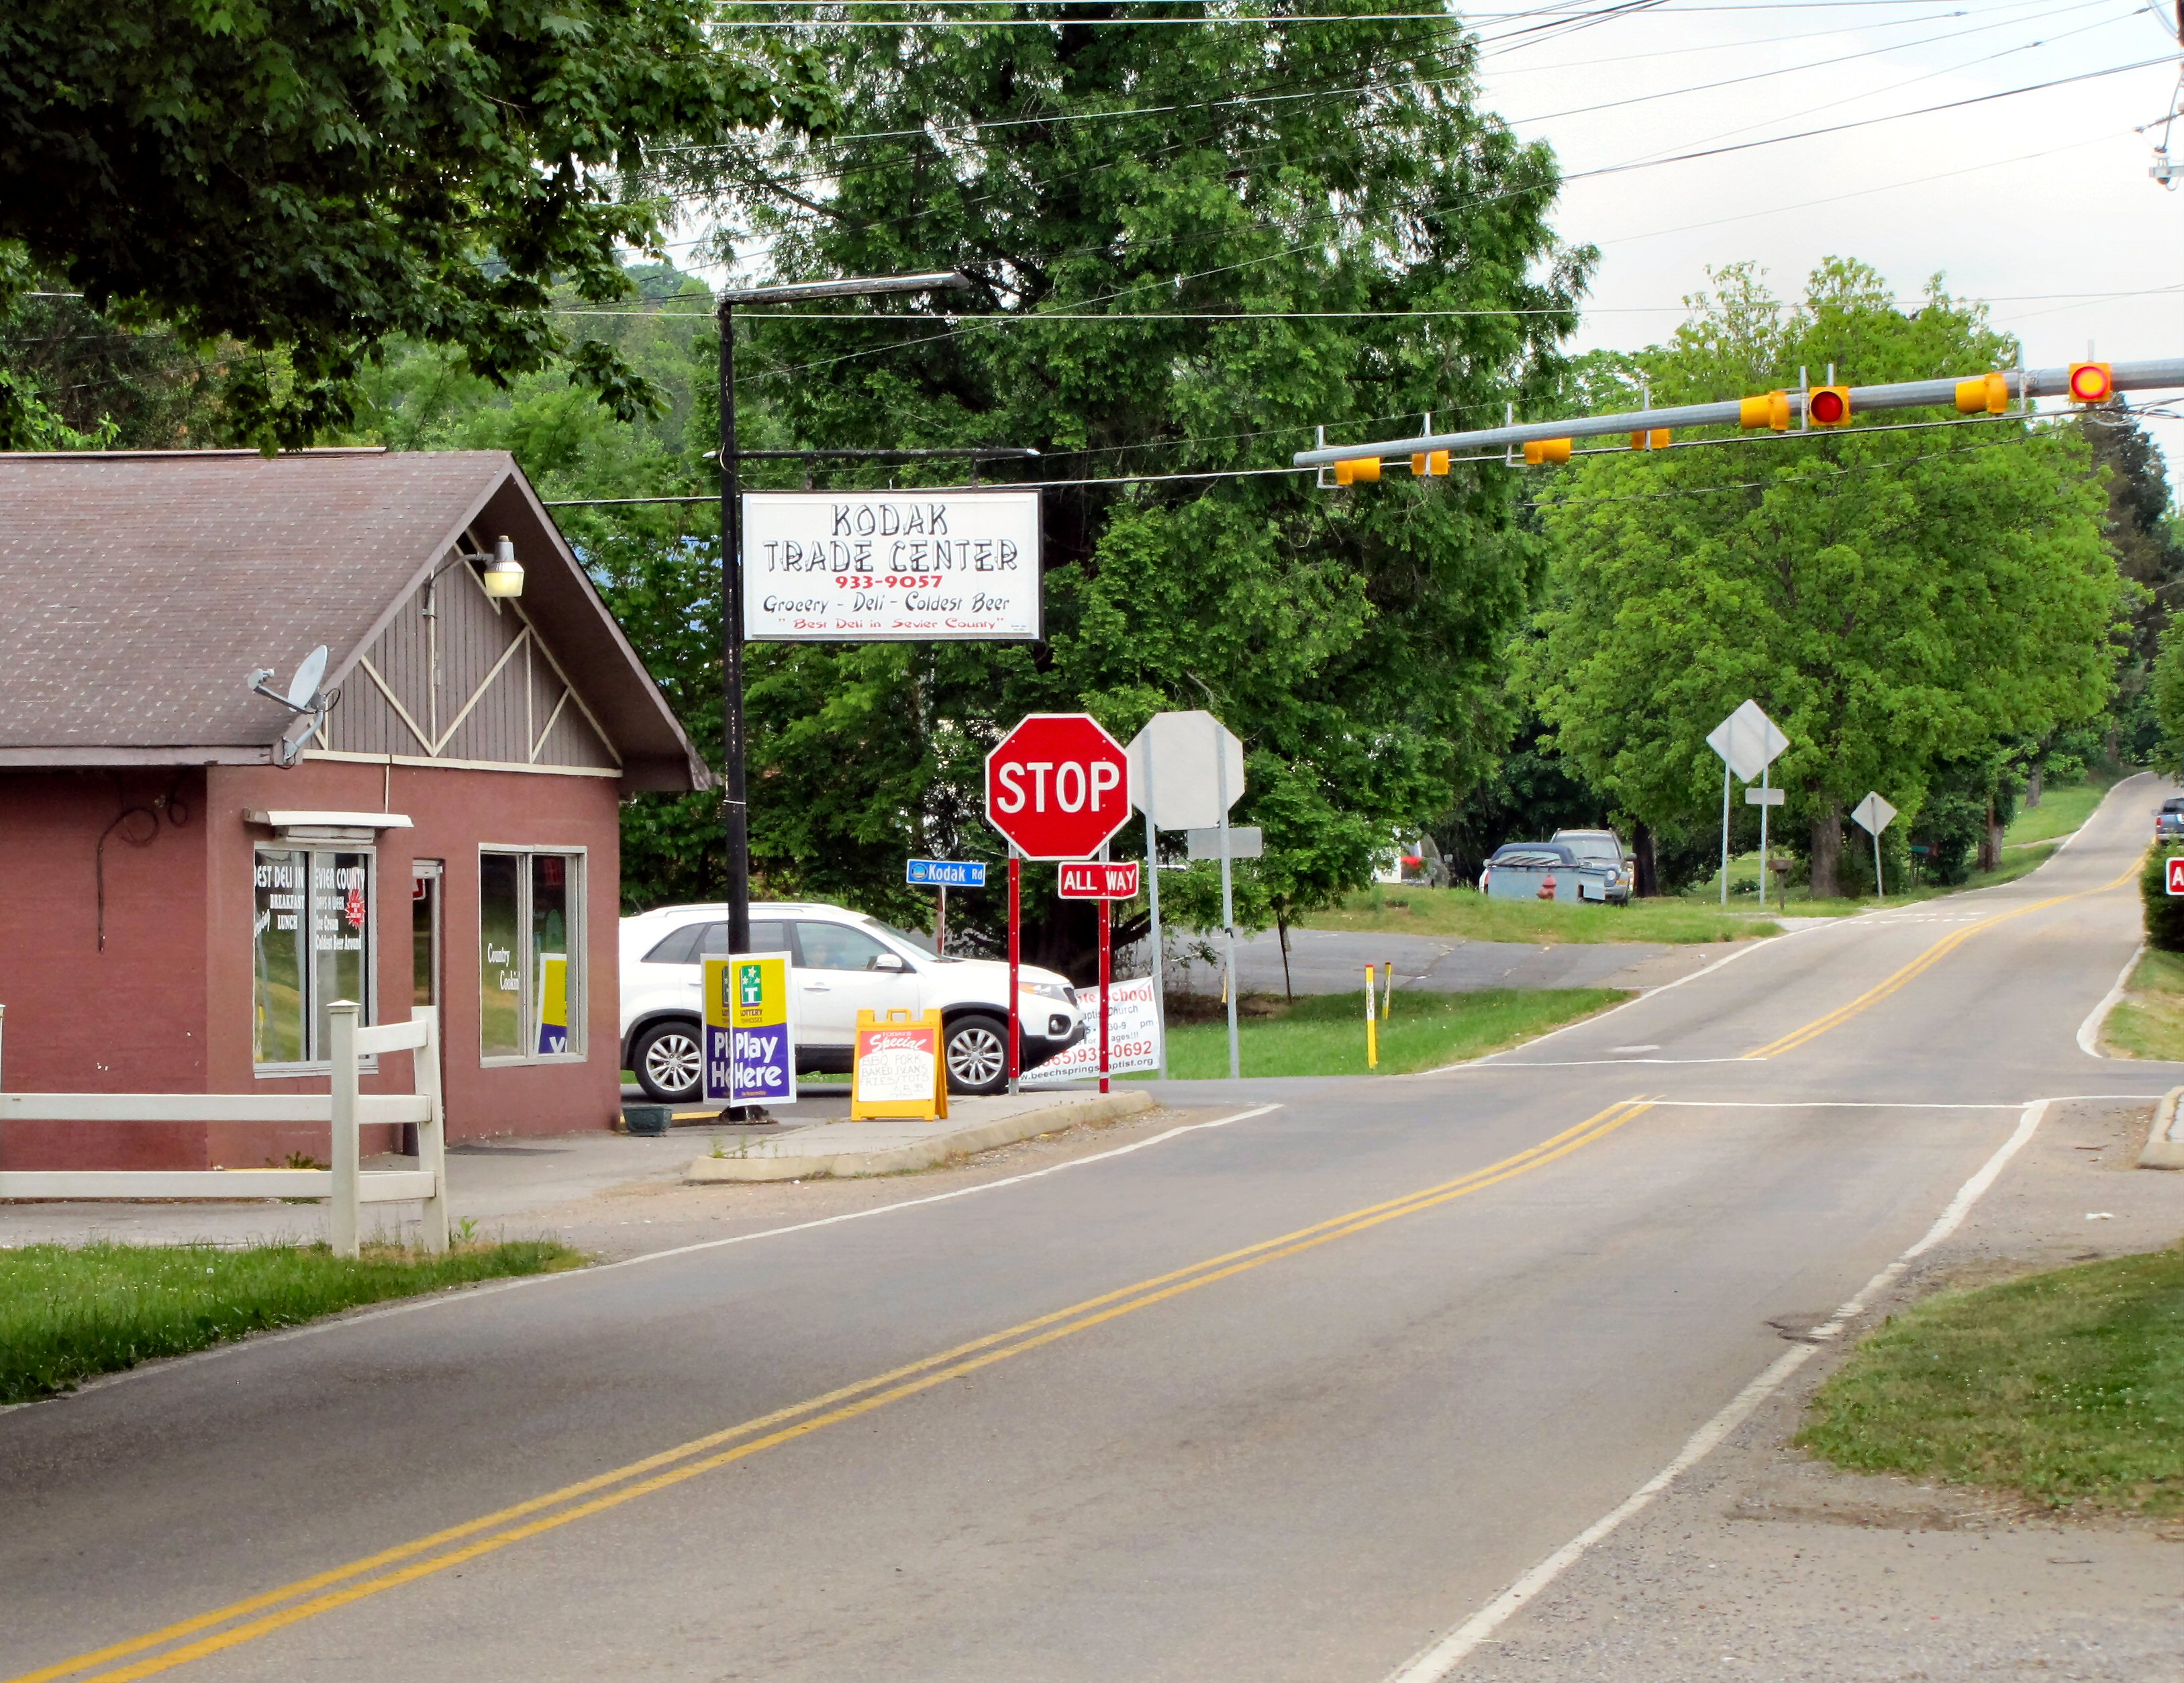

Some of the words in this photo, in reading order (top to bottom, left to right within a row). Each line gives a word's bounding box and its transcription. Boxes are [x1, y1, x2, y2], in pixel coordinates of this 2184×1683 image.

[830, 503, 948, 536] KODAK
[762, 540, 874, 572] TRADE
[889, 539, 1018, 572] CENTER
[835, 575, 943, 589] 933-9057
[763, 595, 830, 615] Grocery
[852, 591, 885, 612] Deli
[905, 590, 962, 611] Coldest
[971, 592, 1009, 613] Beer
[836, 618, 862, 628] Deli
[870, 619, 881, 628] in
[891, 618, 938, 628] Sevier
[997, 761, 1120, 814] STOP
[275, 866, 292, 888] DELI
[295, 866, 304, 888] IN
[315, 867, 334, 889] EVIER
[336, 867, 365, 889] COUNTY
[928, 864, 966, 882] Kodak
[971, 868, 983, 880] Rd
[1063, 870, 1098, 890] ALL
[1105, 869, 1136, 891] WAY
[2171, 866, 2184, 886] A
[277, 915, 298, 929] LUNCH
[1108, 984, 1153, 1002] chool
[1140, 1020, 1154, 1028] pm
[715, 1032, 729, 1058] Pl
[736, 1031, 779, 1063] Play
[869, 1034, 927, 1053] Special
[895, 1053, 922, 1065] PORK
[1020, 1058, 1153, 1081] w.beechspringsaptist.org
[711, 1061, 730, 1088] He
[735, 1062, 782, 1089] Here
[861, 1066, 893, 1077] BAKED
[895, 1064, 928, 1075] BEANS
